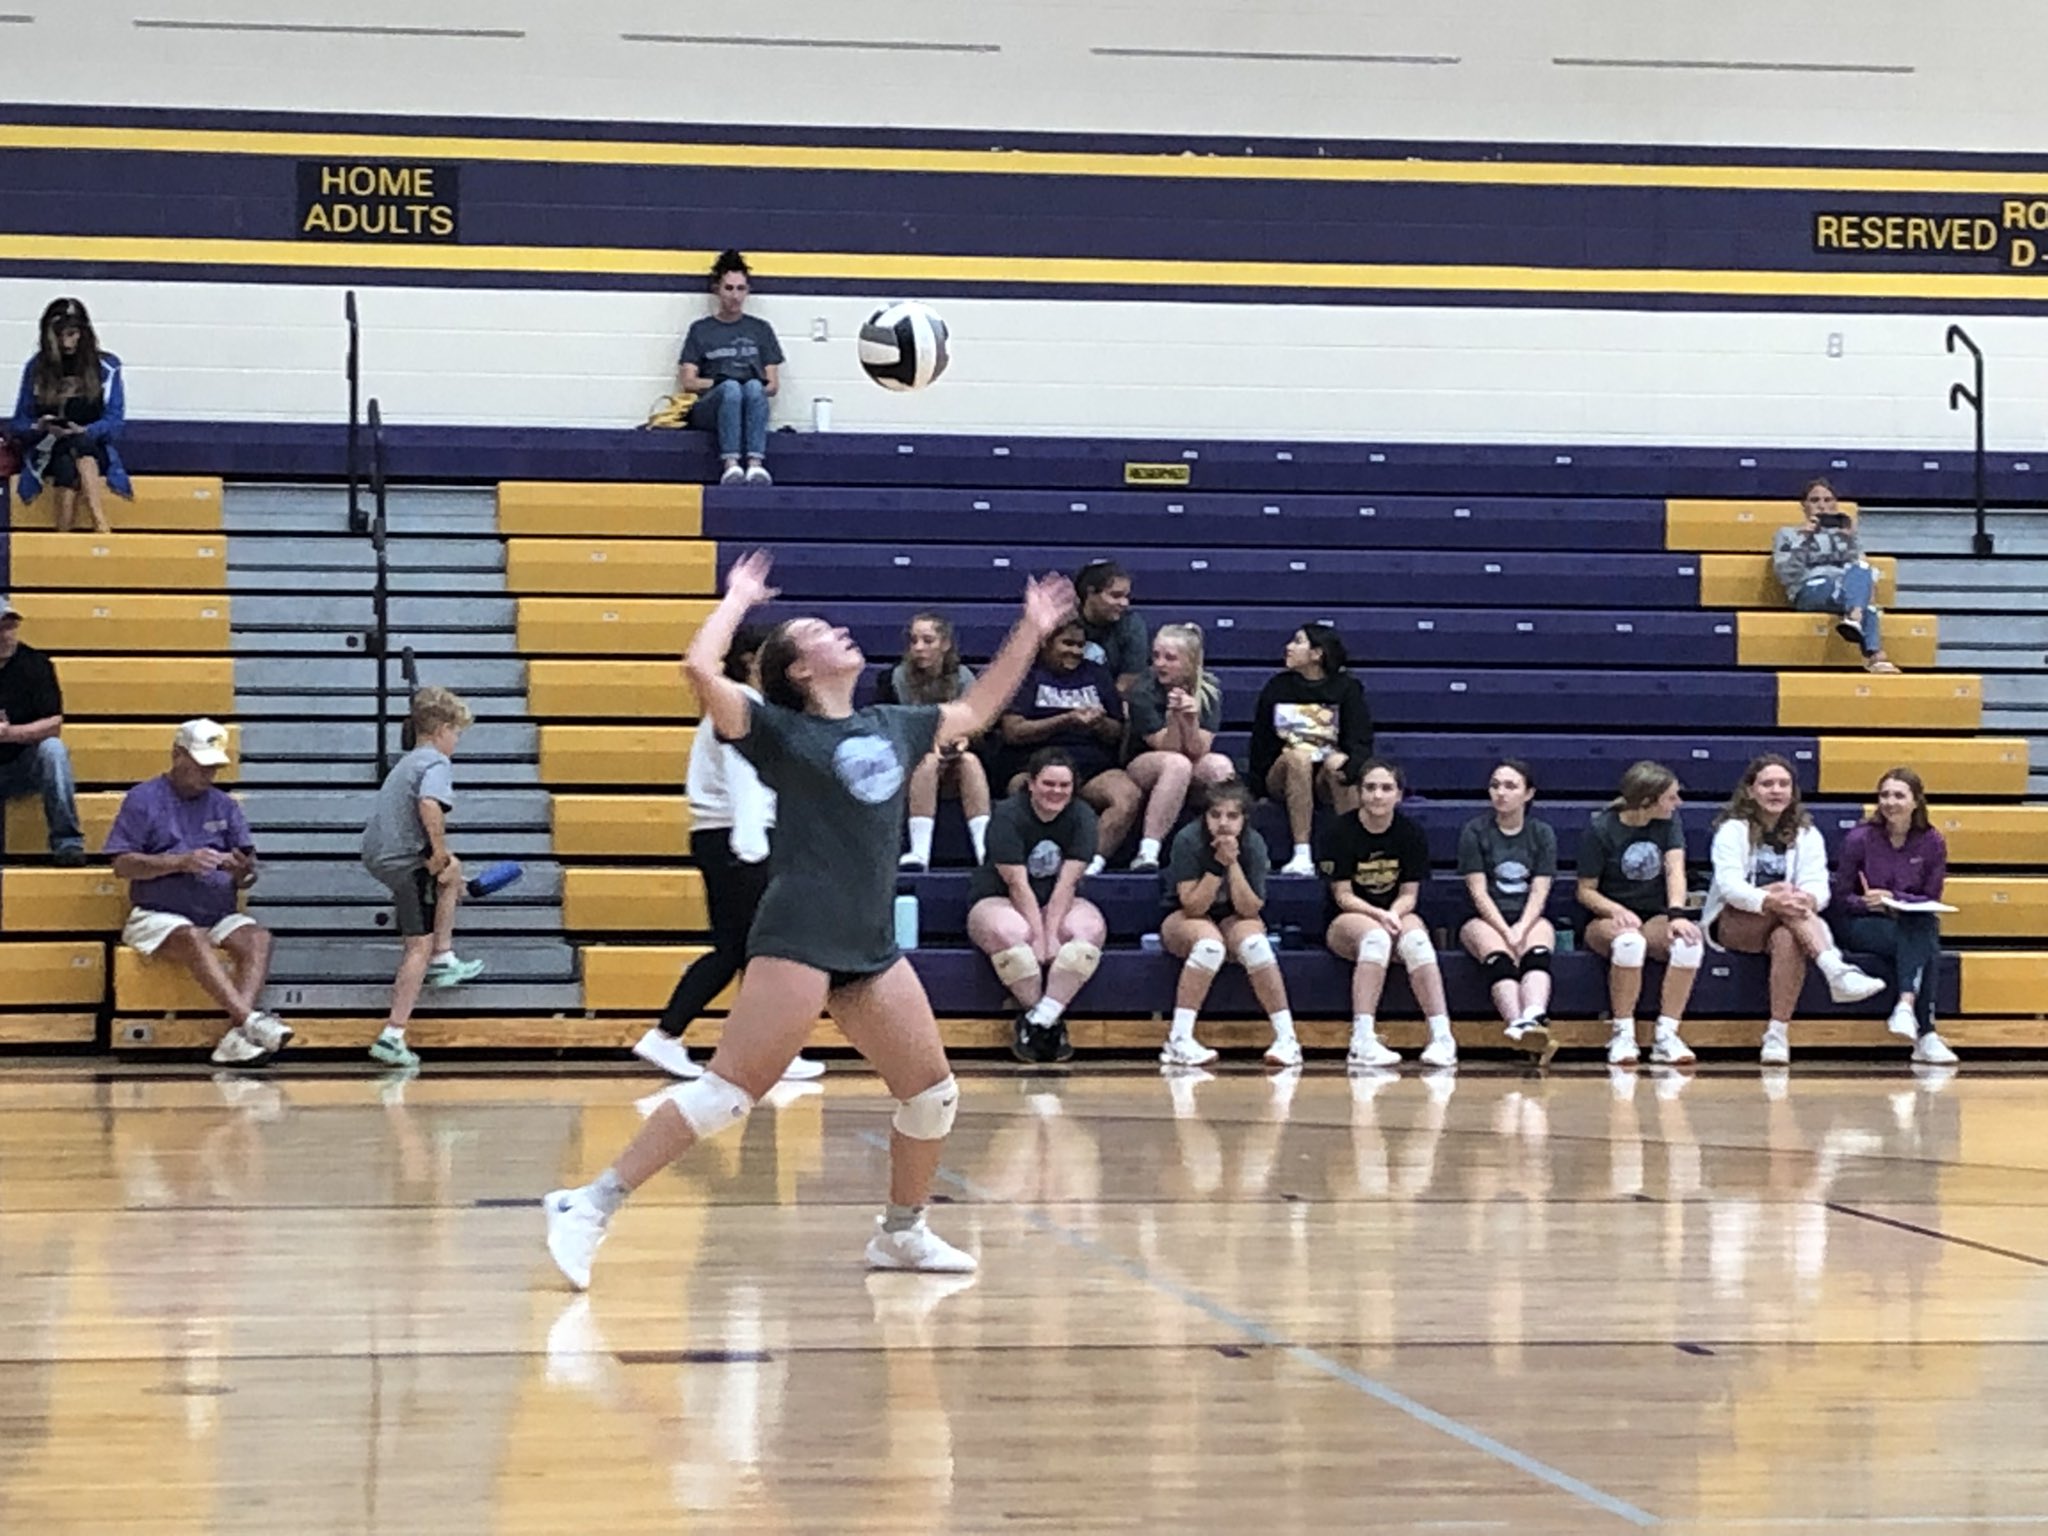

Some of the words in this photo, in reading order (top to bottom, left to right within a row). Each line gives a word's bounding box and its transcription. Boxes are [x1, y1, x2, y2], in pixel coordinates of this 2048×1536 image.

[321, 166, 434, 197] HOME
[303, 203, 454, 235] ADULTS
[2003, 201, 2048, 230] RO
[1817, 215, 1998, 251] RESERVED
